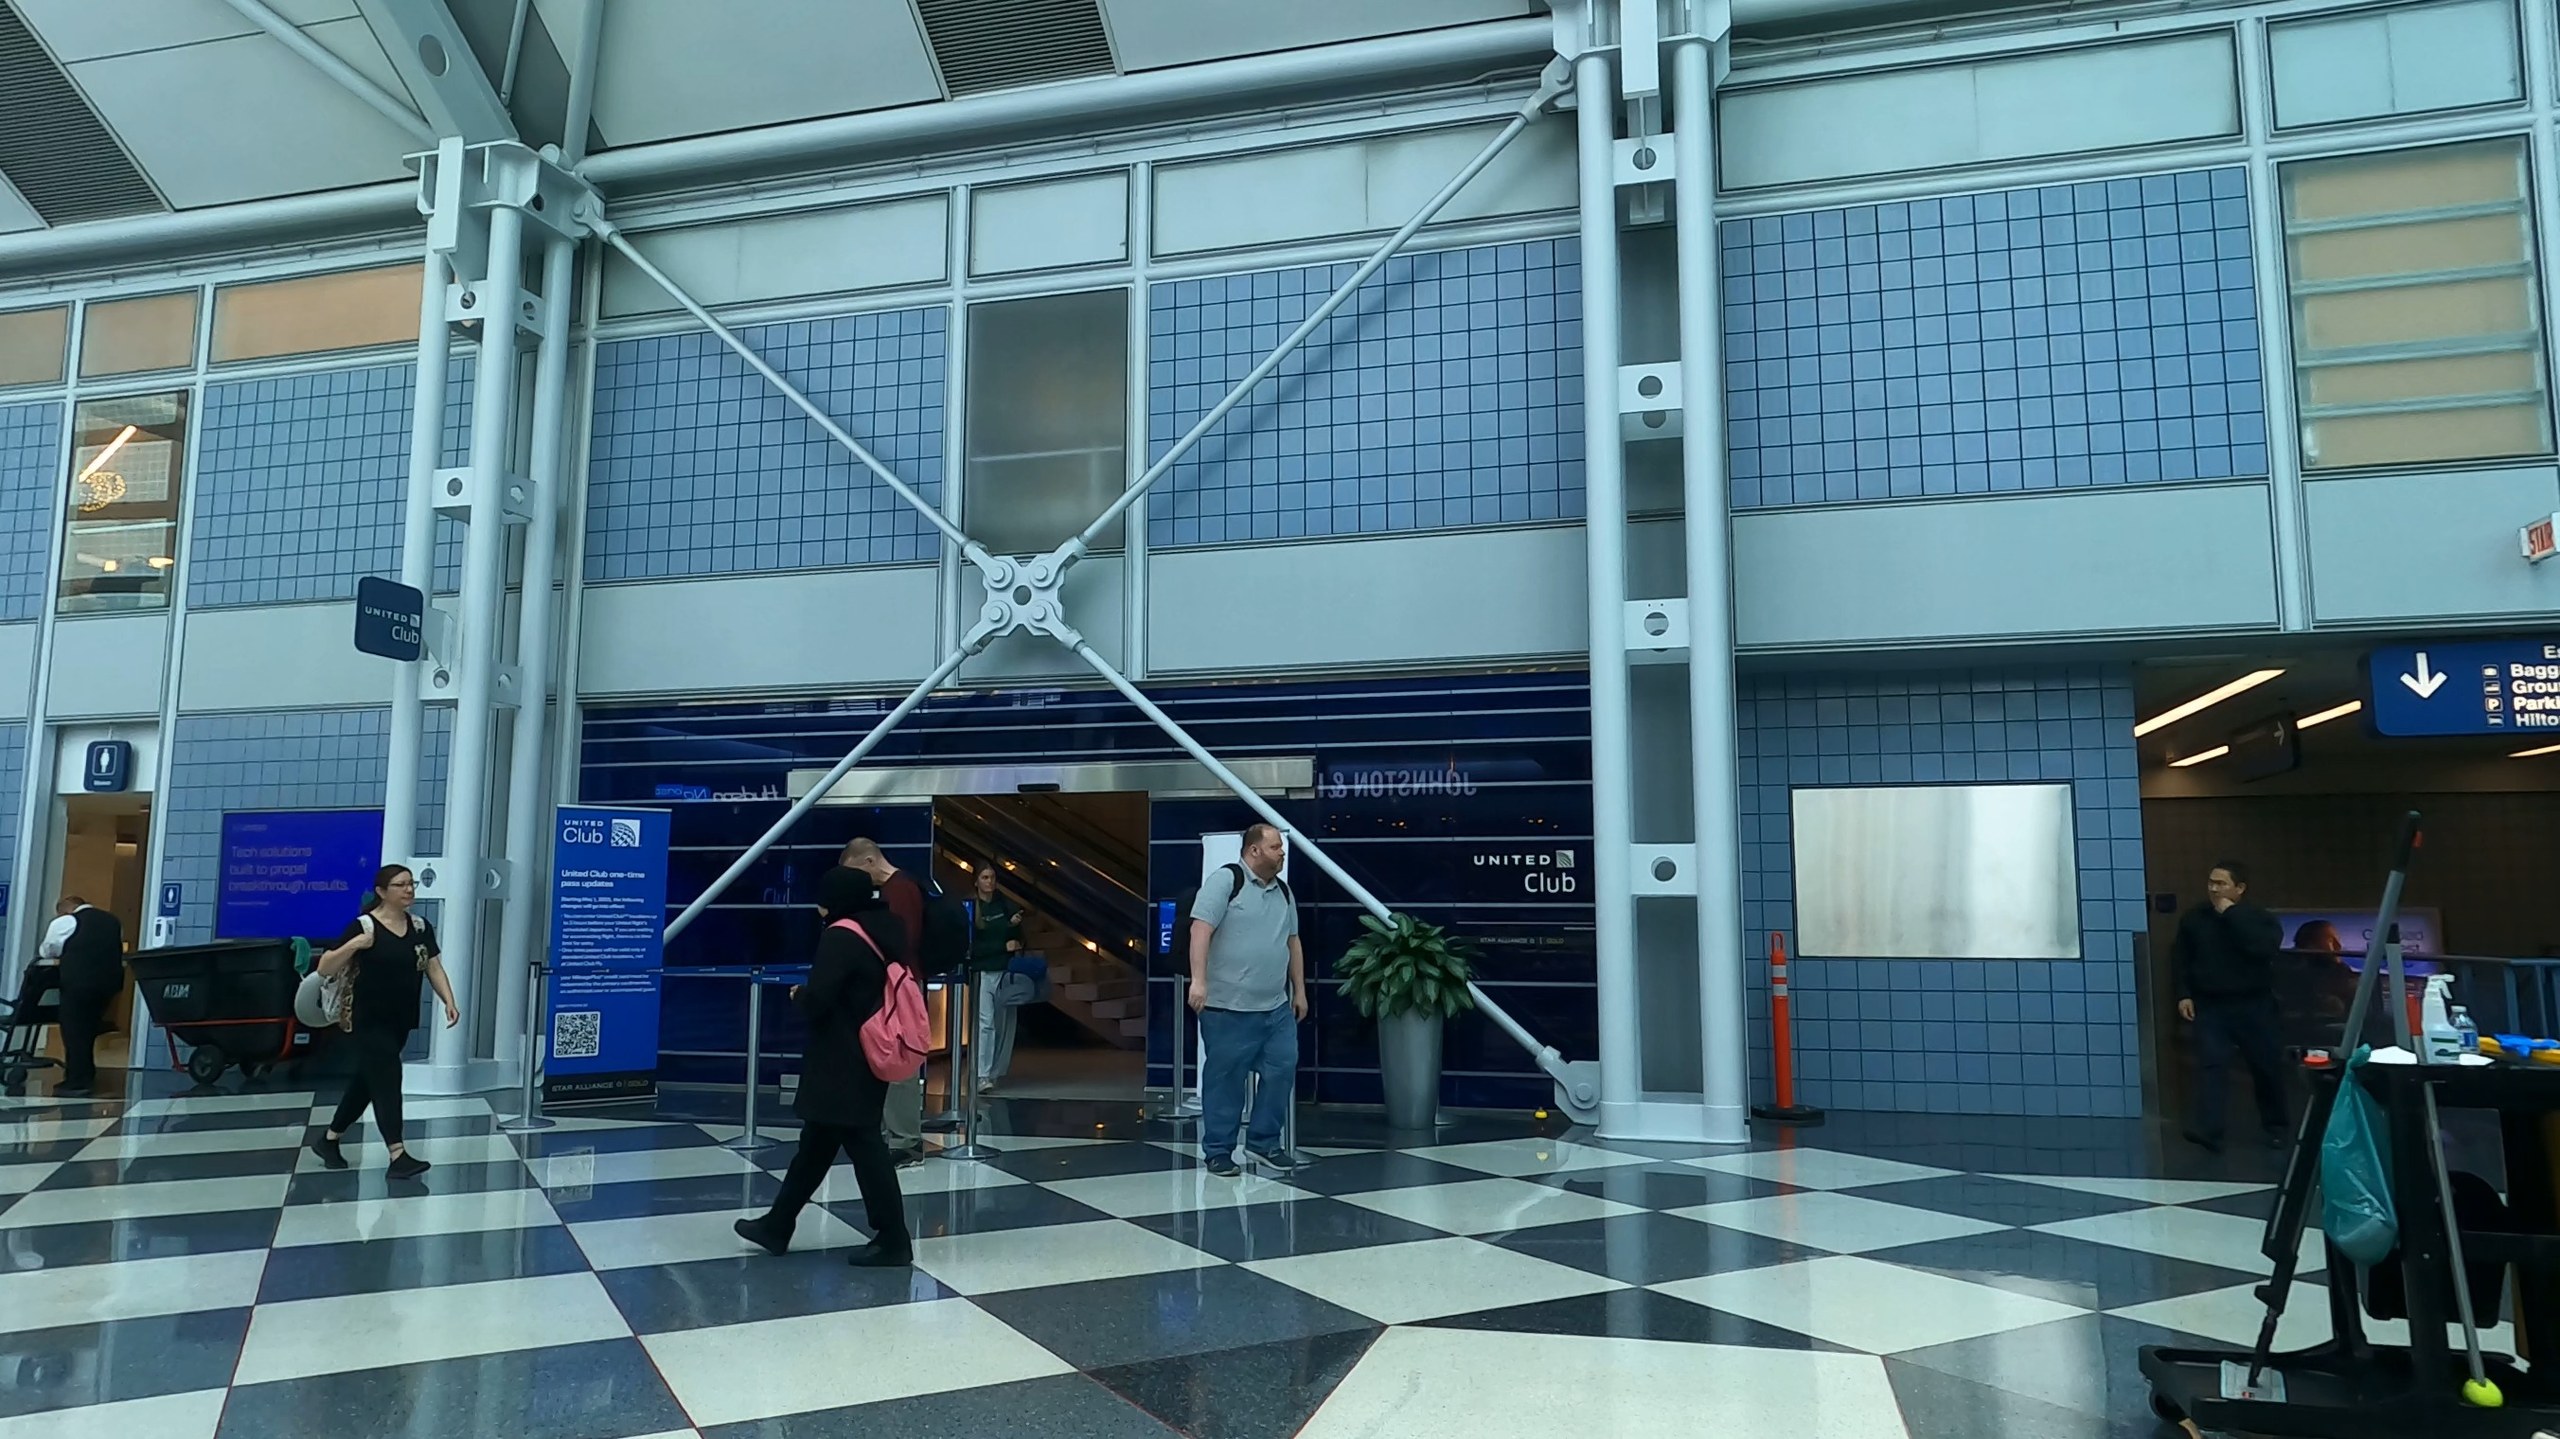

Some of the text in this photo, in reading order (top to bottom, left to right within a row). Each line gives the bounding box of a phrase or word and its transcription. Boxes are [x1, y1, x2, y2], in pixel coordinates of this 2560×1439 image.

[365, 606, 408, 623] UNITED
[391, 625, 419, 644] Club
[2510, 664, 2560, 680] Bagg
[2512, 680, 2560, 694] Grou
[2515, 713, 2560, 727] Hilto
[564, 819, 604, 827] UNITED
[563, 827, 604, 844] Club
[232, 846, 312, 858] Tech solutions
[1473, 854, 1551, 866] UNITED
[230, 863, 307, 876] built to propel
[561, 869, 645, 879] United Club one-time
[228, 880, 306, 895] breakthrough
[581, 881, 614, 889] updates
[1524, 871, 1576, 894] Club
[574, 1081, 613, 1091] ALLIANCE
